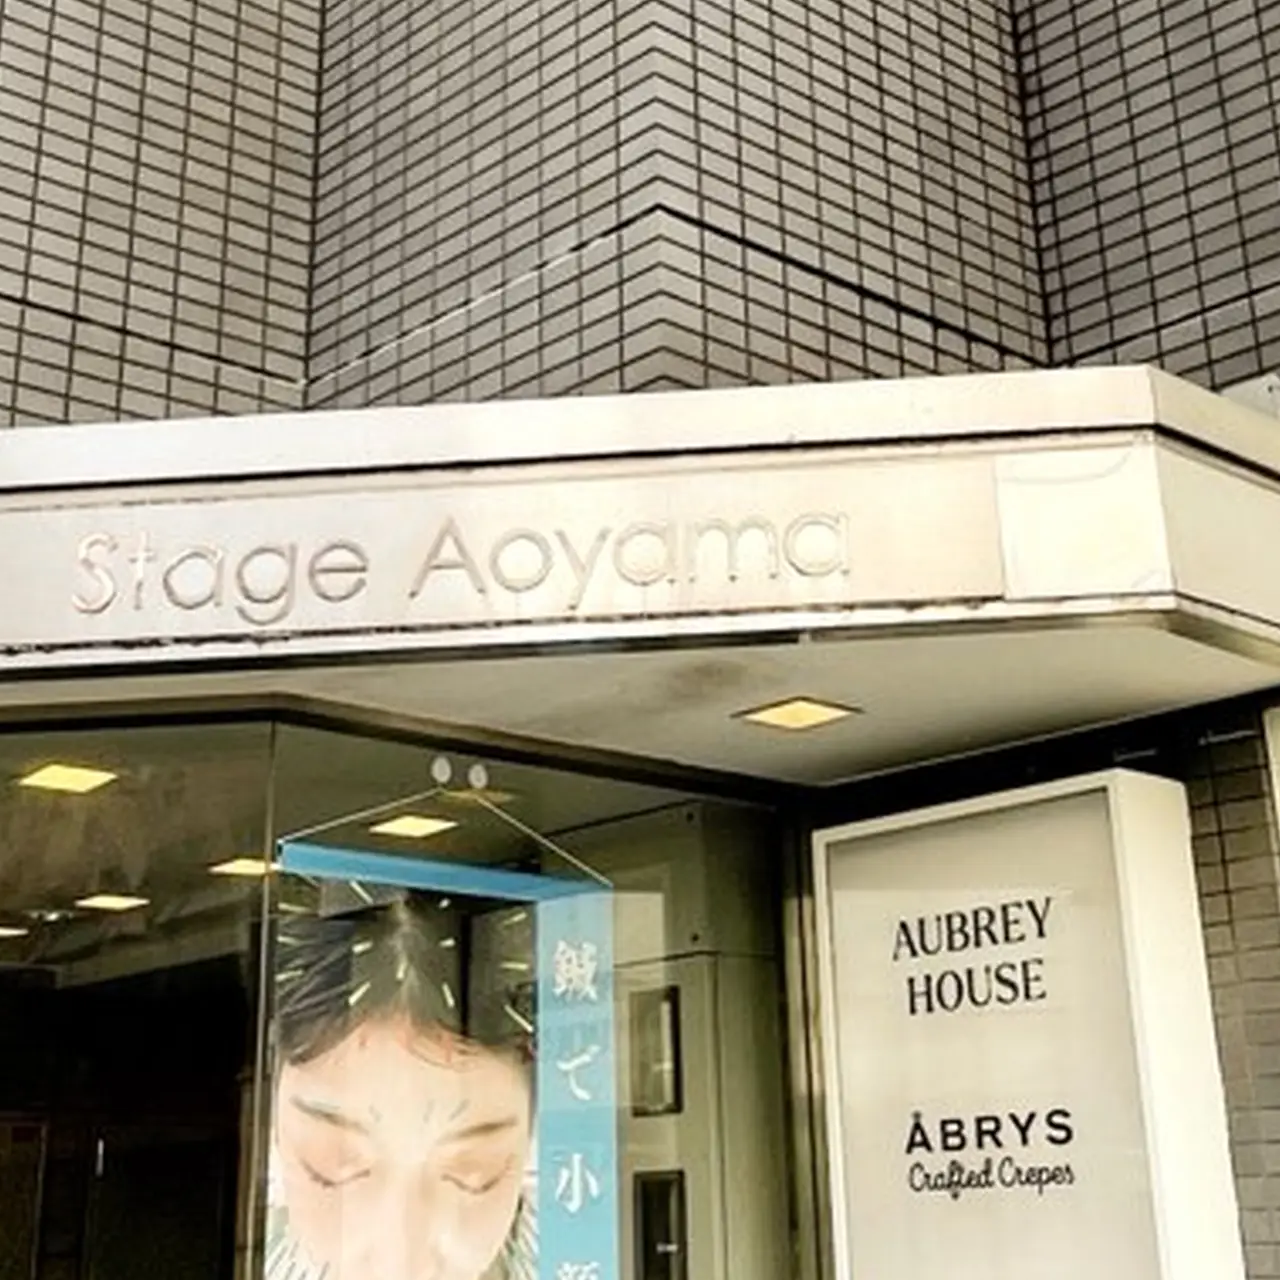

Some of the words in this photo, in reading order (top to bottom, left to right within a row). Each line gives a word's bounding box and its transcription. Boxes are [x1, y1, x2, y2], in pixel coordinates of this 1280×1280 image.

[71, 530, 369, 626] Stage
[409, 513, 850, 610] Aoyama
[892, 896, 1052, 961] AUBREY
[907, 958, 1047, 1015] HOUSE
[908, 1157, 996, 1201] Crafted
[997, 1155, 1075, 1196] Crepes
